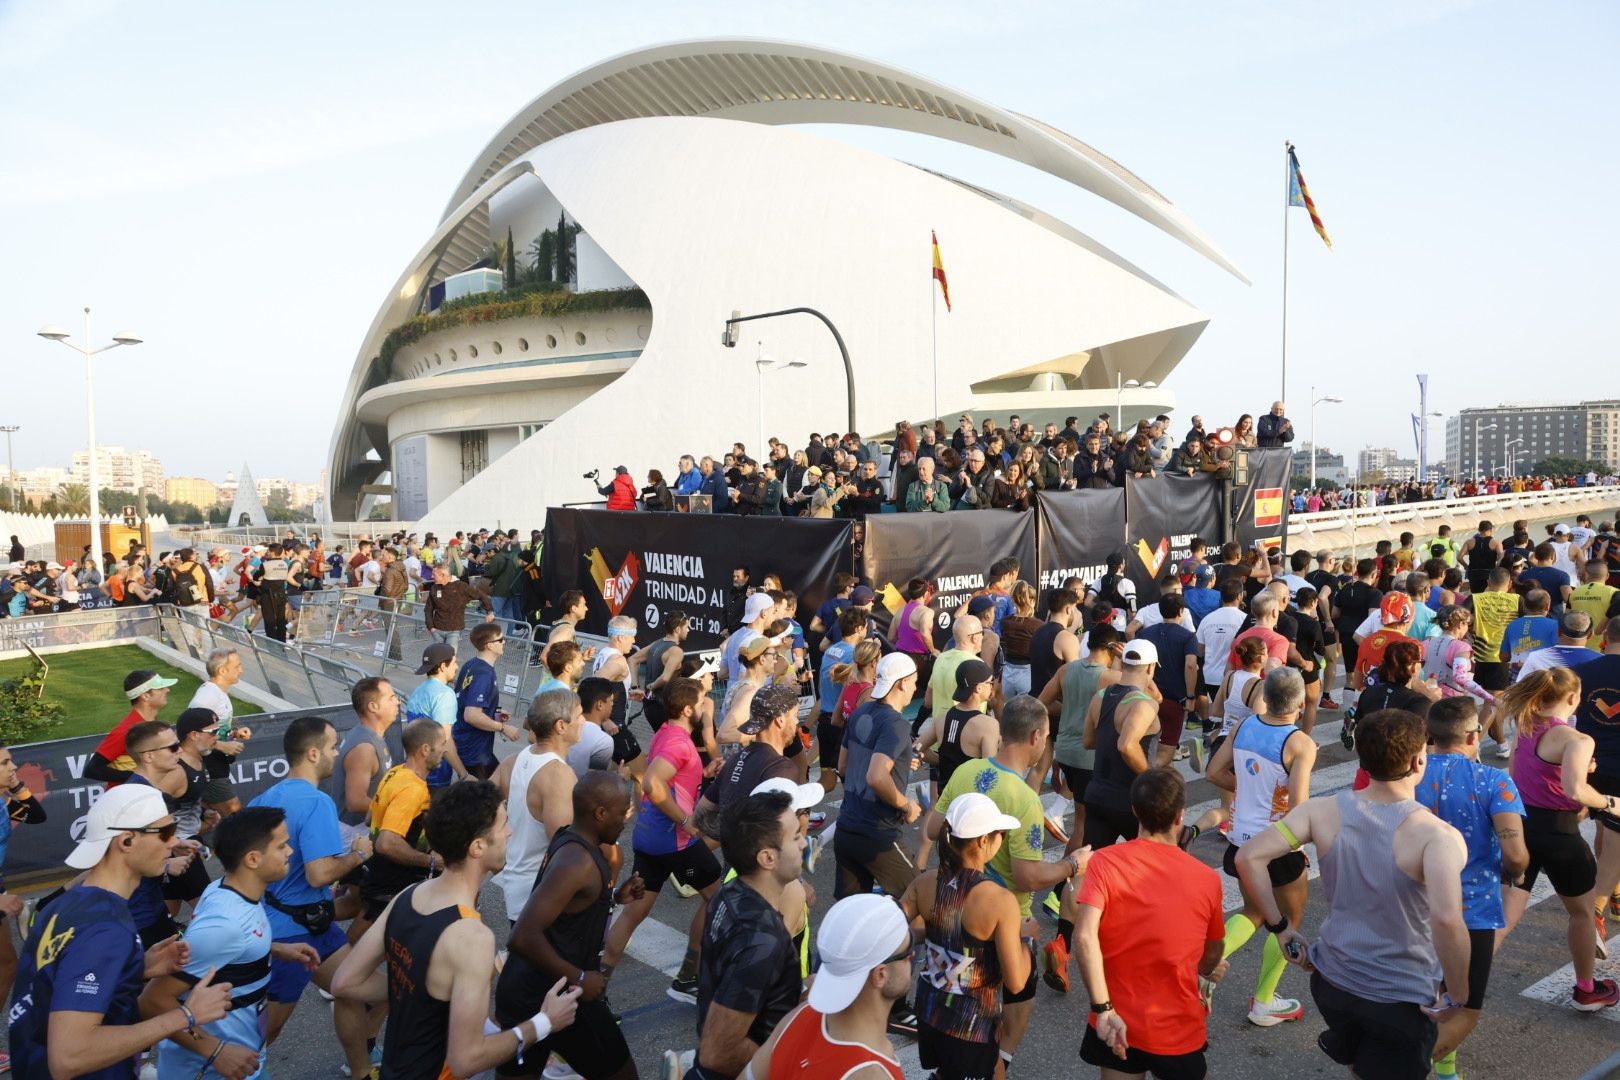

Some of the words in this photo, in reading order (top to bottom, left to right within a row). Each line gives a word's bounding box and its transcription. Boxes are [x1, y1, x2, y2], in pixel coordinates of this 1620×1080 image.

[644, 552, 704, 578] VALENCIA
[614, 565, 634, 606] 42K
[645, 580, 706, 604] TRINIDAD
[938, 574, 984, 592] VALENCIA
